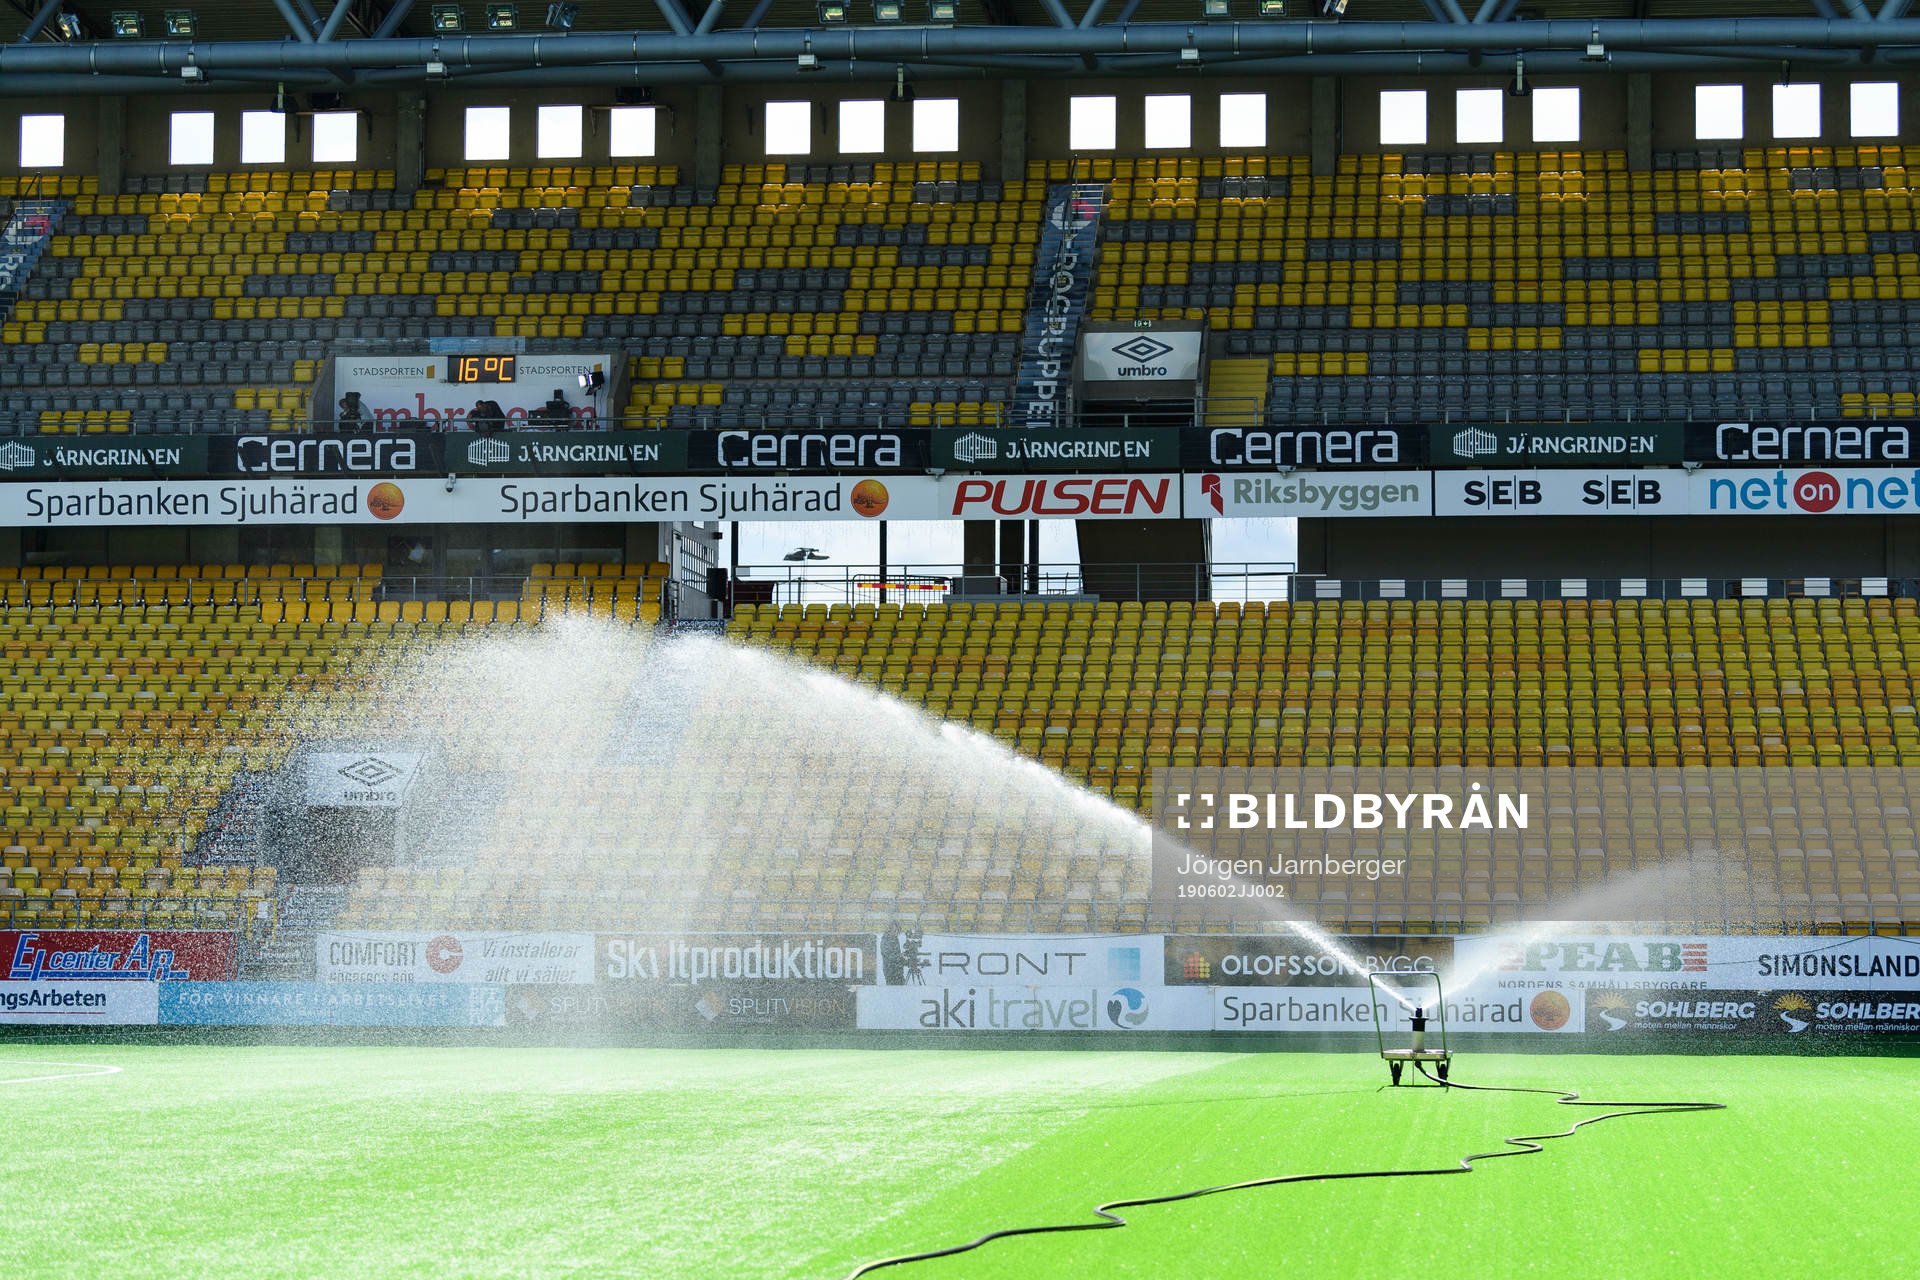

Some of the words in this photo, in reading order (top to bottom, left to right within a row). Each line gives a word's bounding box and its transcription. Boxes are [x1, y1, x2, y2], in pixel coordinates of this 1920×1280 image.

[353, 367, 424, 376] STADSPORTEN
[519, 365, 592, 375] STADSPORTEN
[1117, 364, 1168, 378] umbro
[237, 436, 416, 472] Cernera
[717, 430, 902, 467] Cernera
[1005, 437, 1153, 459] JÄRNGRINDEN
[1210, 428, 1399, 465] Cernera
[1505, 432, 1656, 454] JÄRNGRINDEN
[1715, 423, 1910, 460] Cernera
[500, 484, 688, 519] Sparbanken
[699, 482, 842, 518] Sjuhärad
[952, 479, 1171, 515] PULSEN
[1234, 477, 1419, 510] Riksbyggen
[1463, 475, 1543, 510] SEB
[1582, 474, 1662, 509] SEB
[1709, 469, 1788, 510] net
[1800, 483, 1834, 501] on
[26, 488, 210, 523] Sparbanken
[219, 486, 358, 522] Sjuhärad
[49, 944, 121, 969] center
[329, 942, 417, 966] COMFORT
[482, 940, 497, 958] Vi
[501, 941, 581, 959] installerar
[1522, 943, 1684, 972] PEAB
[485, 970, 508, 982] allt
[1366, 956, 1435, 974] BYGG
[1758, 954, 1920, 977] SIMONSLAND
[919, 989, 976, 1028] aki
[988, 989, 1098, 1028] travel
[1223, 997, 1387, 1026] Sparbanken
[1635, 1002, 1756, 1018] SOHLBERG
[1816, 1023, 1843, 1031] möten
[1845, 1023, 1872, 1031] mellan
[1875, 1023, 1920, 1031] människor
